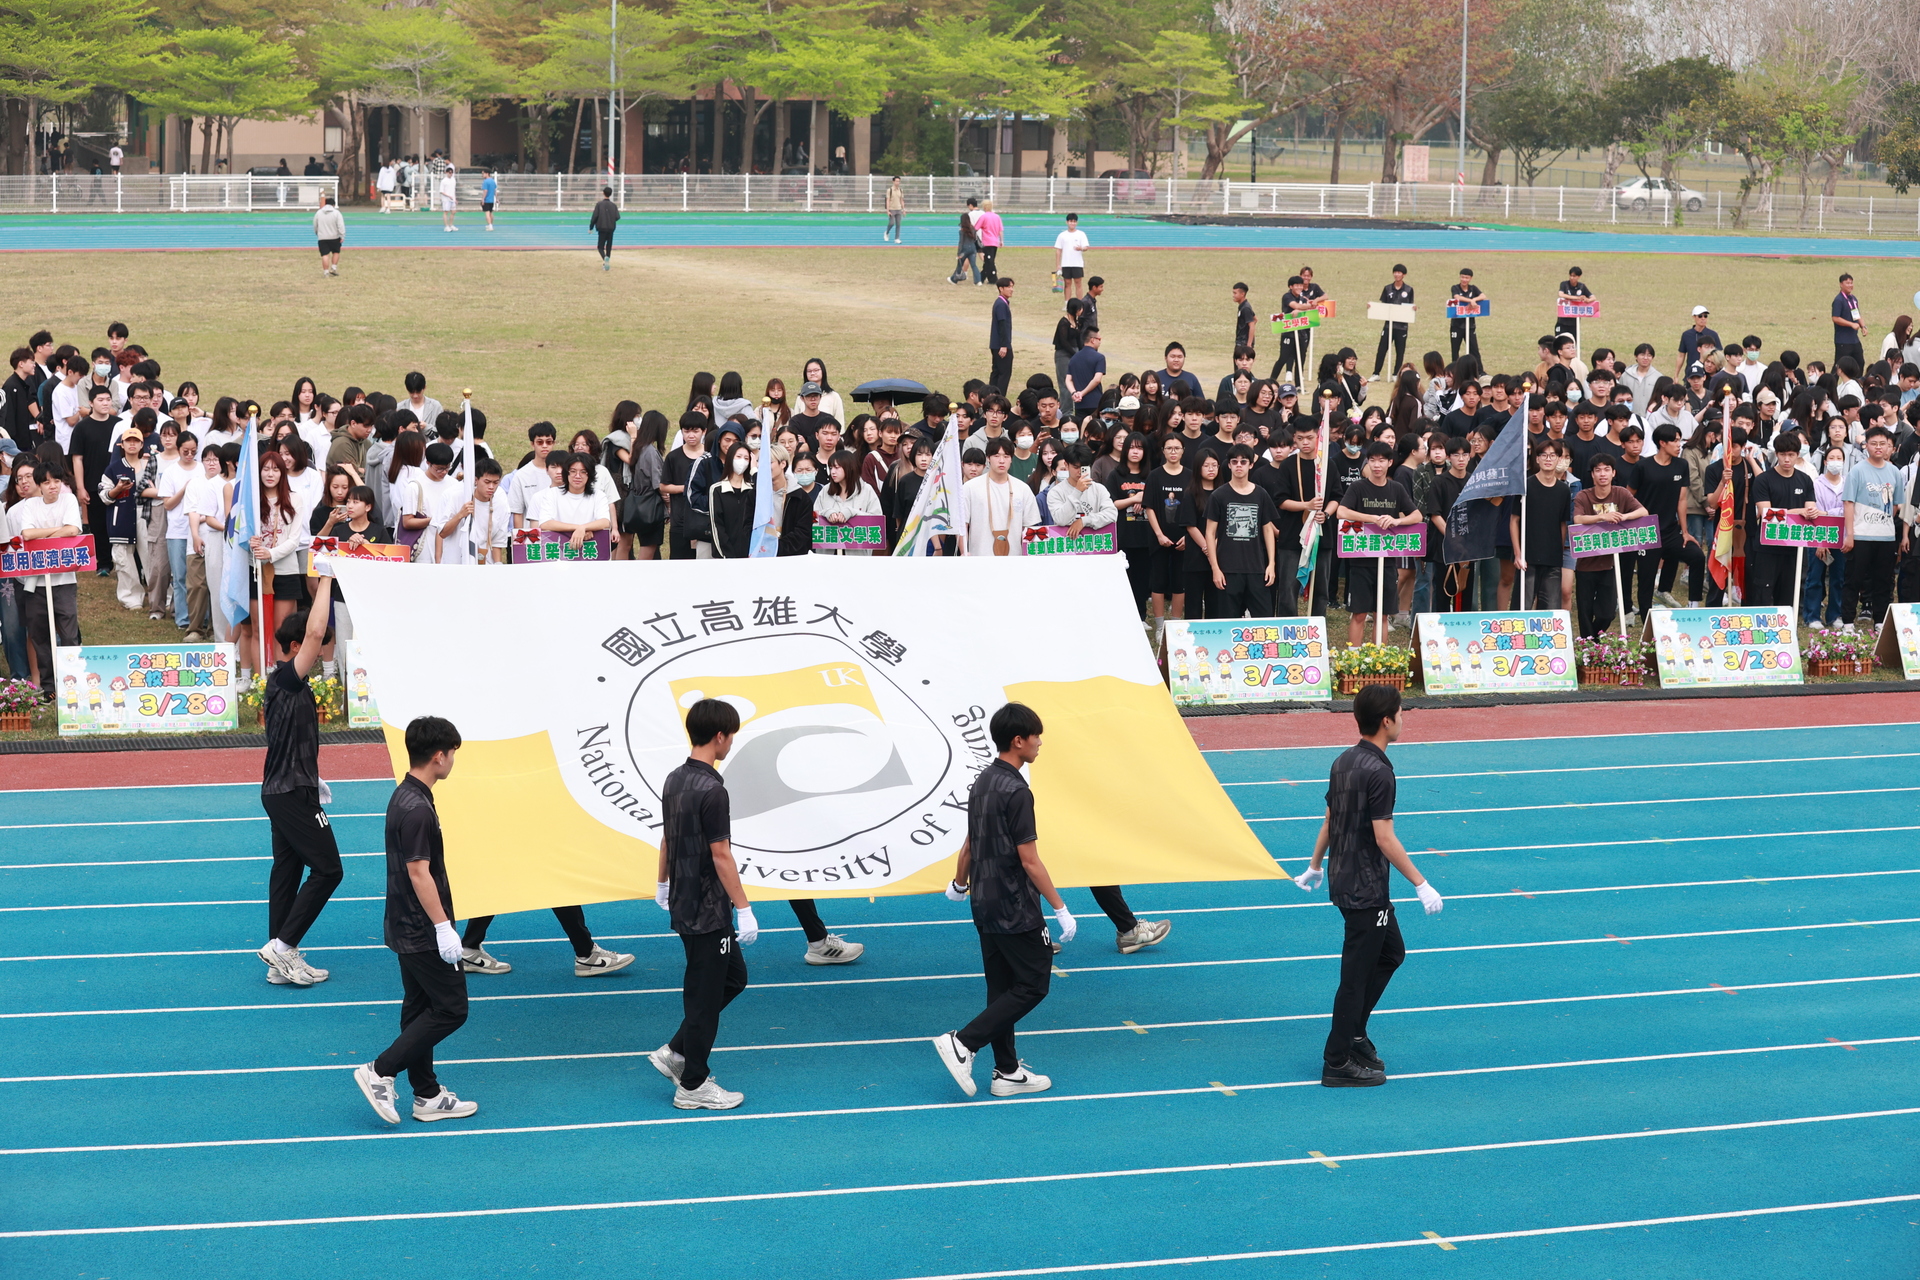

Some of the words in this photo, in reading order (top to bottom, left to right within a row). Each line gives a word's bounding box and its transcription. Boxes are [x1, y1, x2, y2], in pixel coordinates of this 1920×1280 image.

[1283, 317, 1309, 329] 工學院
[1363, 498, 1396, 508] Timberland
[812, 525, 882, 544] 亞語文學系
[1342, 533, 1421, 553] 西洋語文學系
[1573, 525, 1658, 553] 工藝與創意設計學系
[1765, 523, 1839, 544] 運動競技學系
[2, 546, 90, 572] 應用經濟學系
[527, 540, 598, 561] 建築學系
[601, 596, 908, 667] 國立高雄大學
[1481, 619, 1526, 634] 26週年
[1711, 615, 1753, 629] 26週年
[1232, 627, 1279, 642] 26週年
[1482, 633, 1567, 650] 全校運動大會
[1712, 628, 1792, 645] 全校運動大會
[1233, 641, 1322, 659] 全校運動大會
[129, 653, 181, 669] 26週年
[1493, 655, 1550, 677] 3/28
[1724, 650, 1778, 671] 3/28
[128, 669, 229, 687] 全校運動大會
[1244, 664, 1304, 687] 3/28
[139, 692, 207, 717] 3/28
[577, 722, 664, 831] National
[738, 845, 888, 883] iversity
[910, 813, 952, 847] of
[315, 811, 329, 828] 18
[1376, 909, 1389, 927] 26
[720, 936, 731, 955] 31
[1041, 926, 1050, 946] 19
[437, 1097, 457, 1110] N
